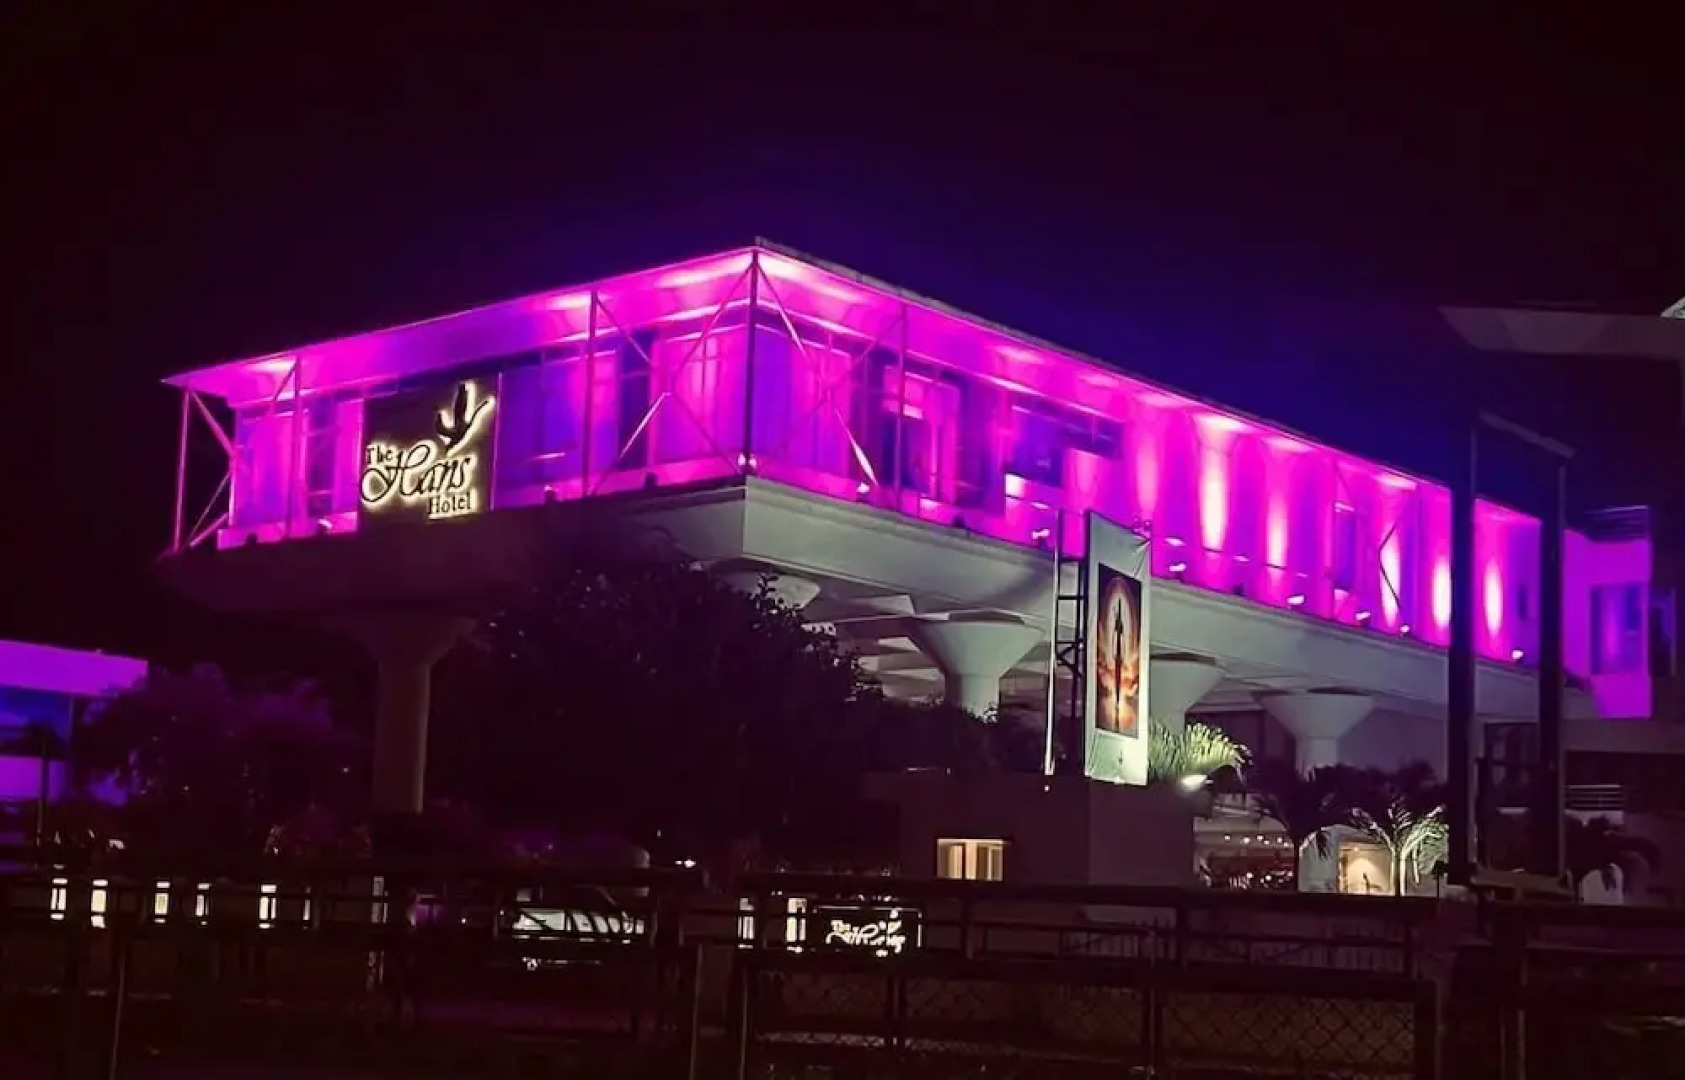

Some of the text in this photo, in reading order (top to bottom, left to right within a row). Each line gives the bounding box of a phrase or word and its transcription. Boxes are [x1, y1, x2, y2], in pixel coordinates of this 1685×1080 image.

[366, 445, 394, 464] The
[361, 444, 471, 503] Hans
[429, 491, 471, 515] Hotel
